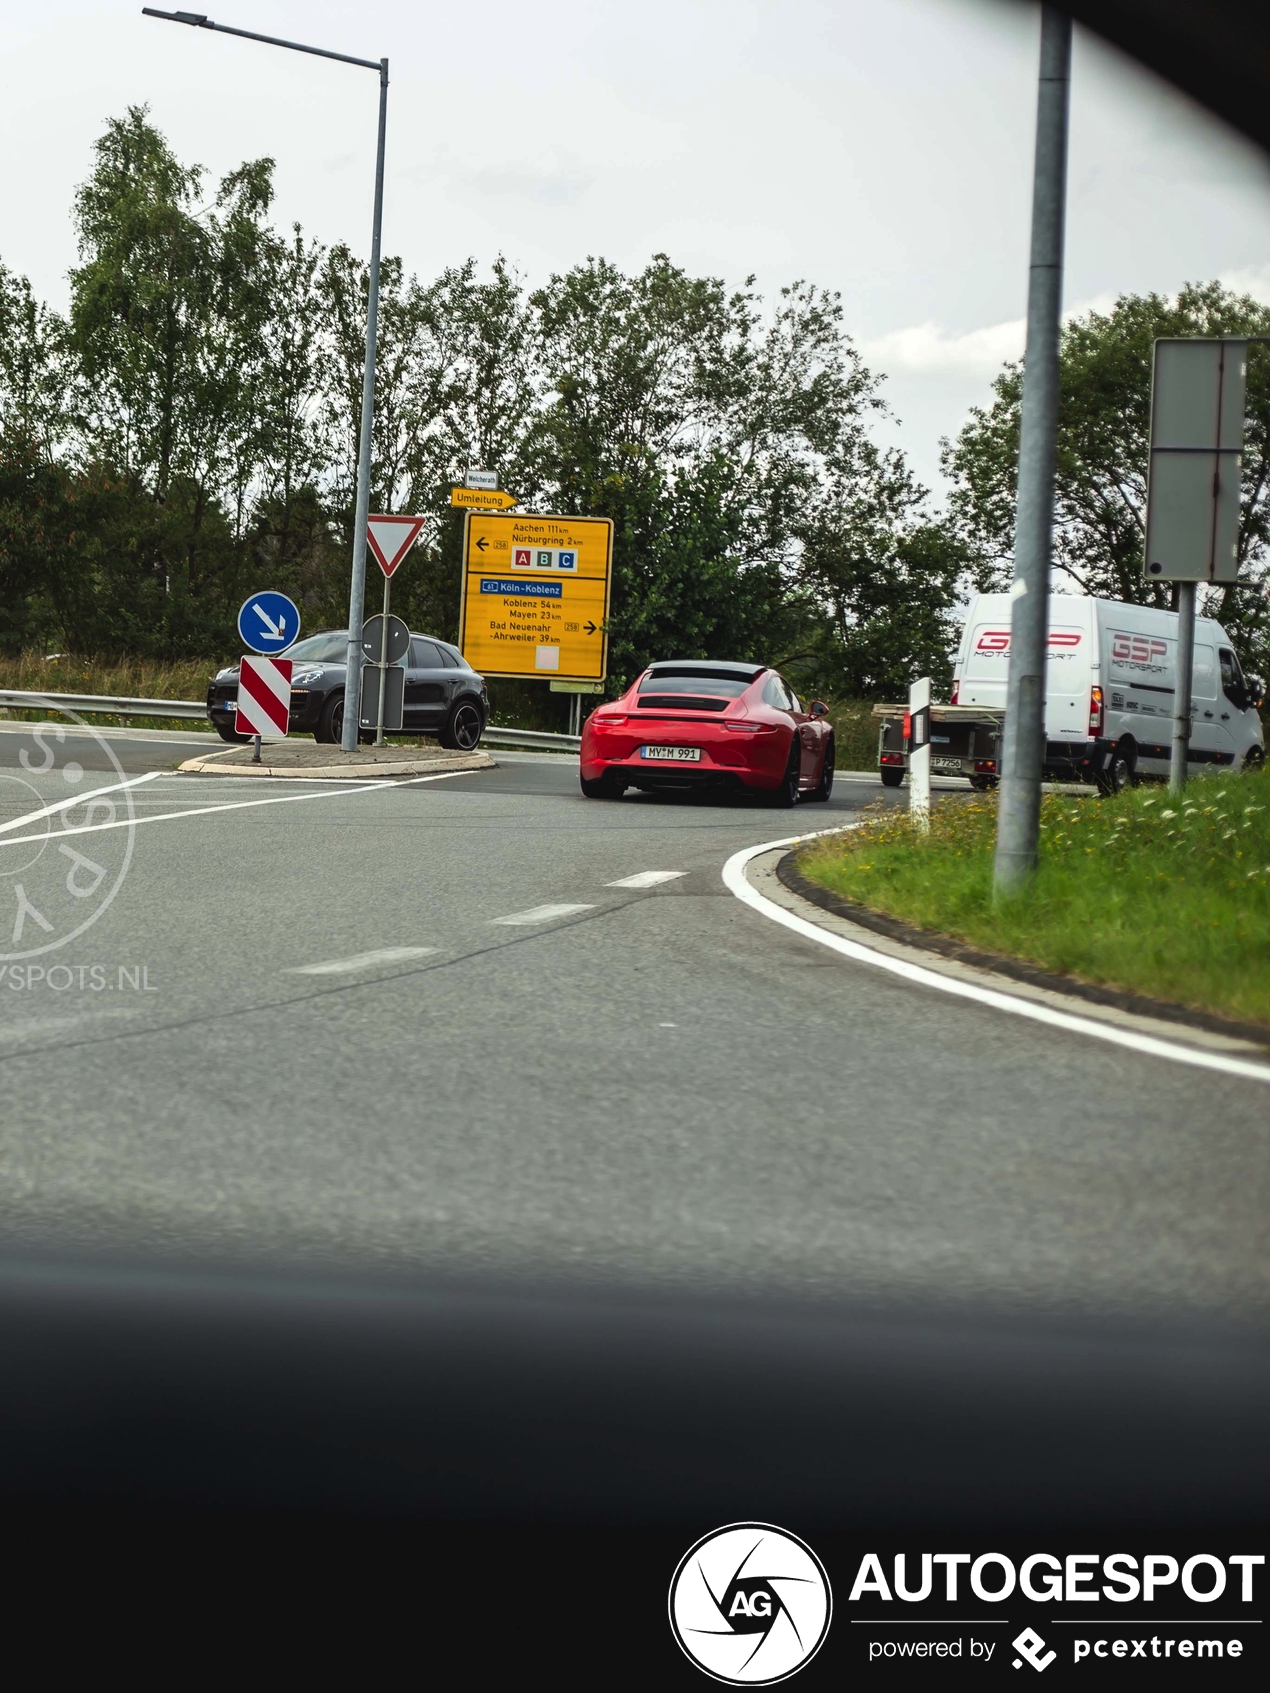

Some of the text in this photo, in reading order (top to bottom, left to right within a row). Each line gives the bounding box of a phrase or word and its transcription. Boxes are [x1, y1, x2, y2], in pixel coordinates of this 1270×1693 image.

[457, 493, 503, 507] Umleitung
[513, 523, 544, 533] Aachen
[495, 541, 507, 549] 258
[512, 534, 564, 546] Nürburgring
[518, 552, 571, 566] A B C
[503, 599, 537, 607] Koblenz
[540, 601, 551, 609] 54
[509, 610, 537, 620] Mayen
[540, 611, 551, 619] 23
[490, 621, 552, 632] Bad Neuenahr
[566, 623, 578, 631] 258
[489, 632, 536, 642] -Ahrweiler
[539, 634, 549, 643] 39
[977, 631, 1081, 650] GP
[1112, 634, 1167, 662] GSP
[1111, 659, 1168, 674] MOTORSPORT
[678, 748, 696, 759] 991
[942, 758, 960, 767] 7256
